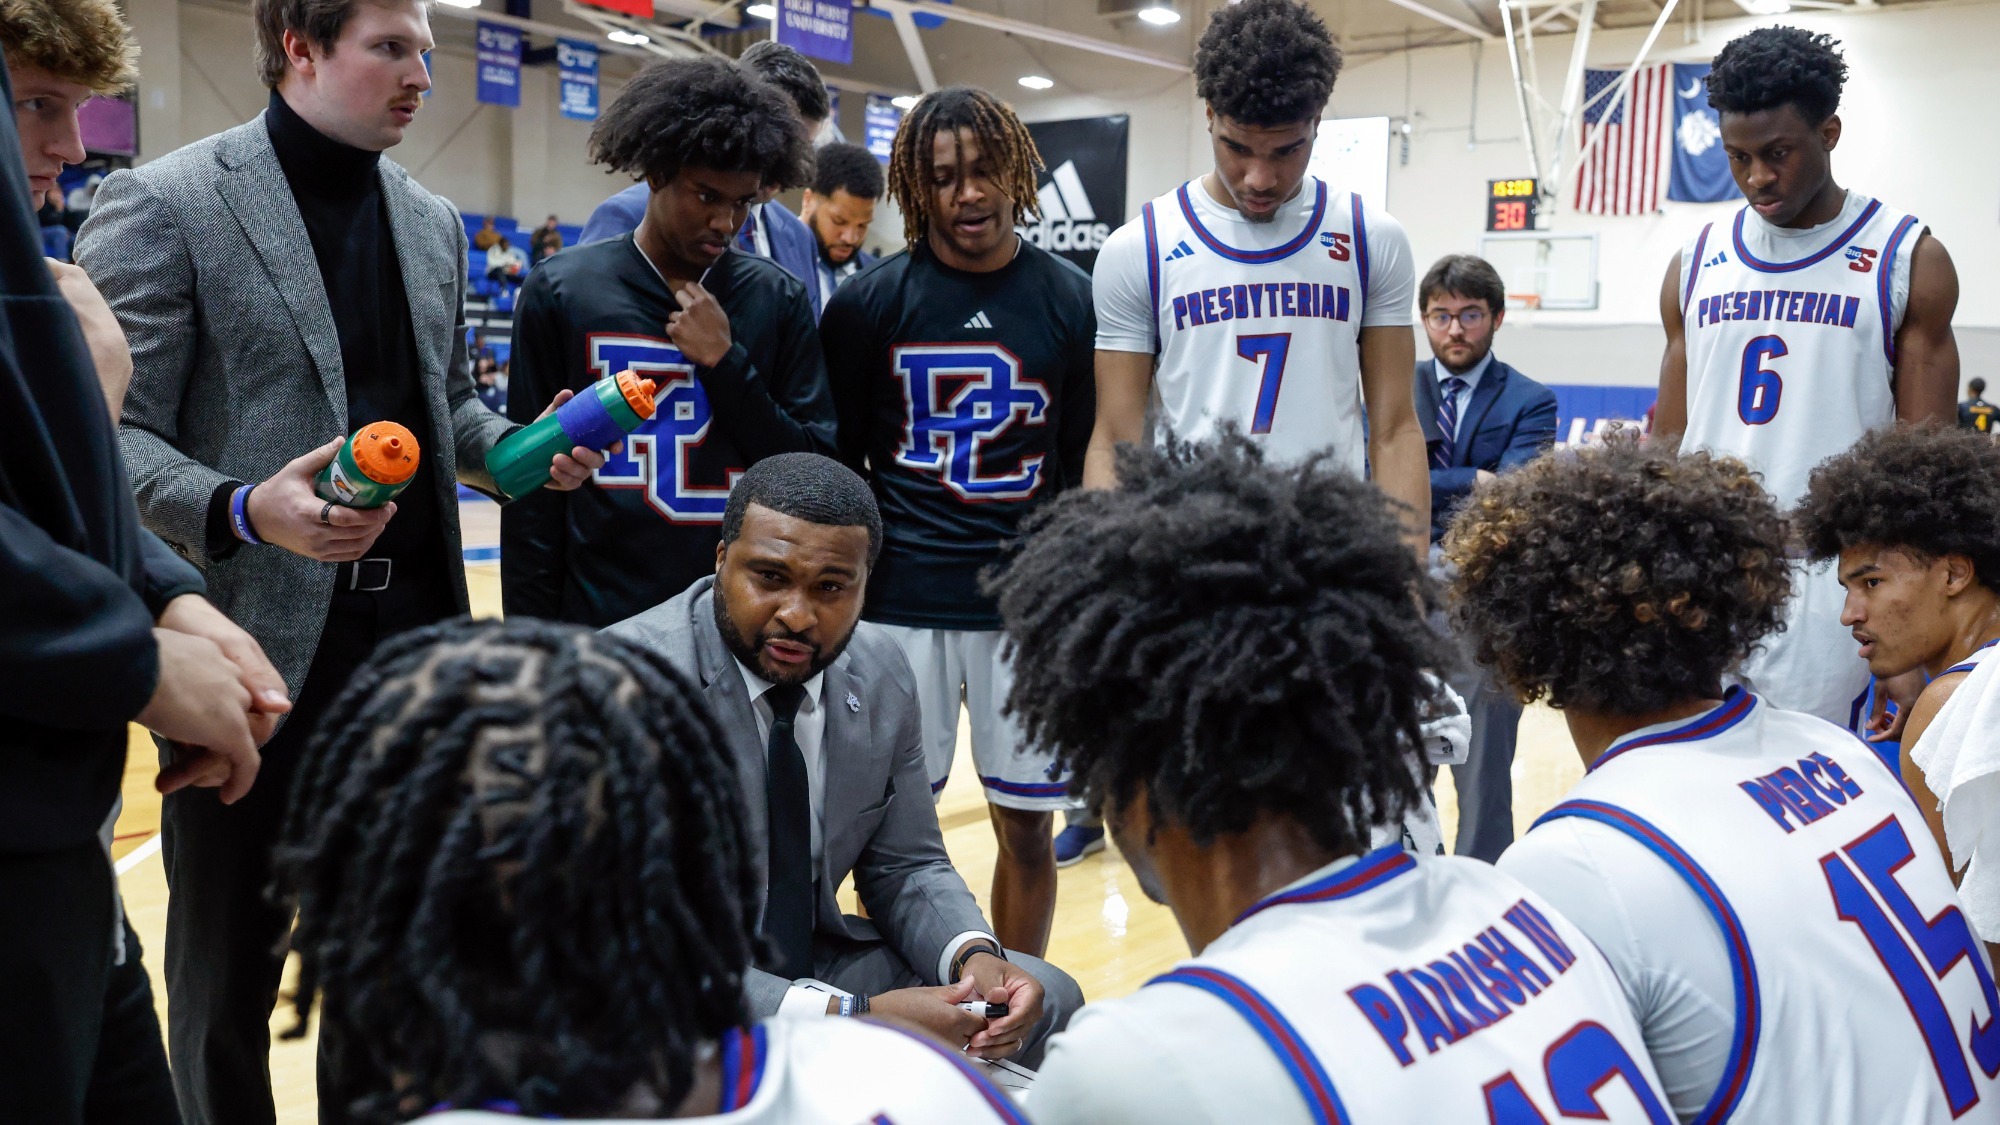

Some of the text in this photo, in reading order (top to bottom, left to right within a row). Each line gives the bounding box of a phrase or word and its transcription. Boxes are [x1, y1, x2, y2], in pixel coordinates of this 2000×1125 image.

[1328, 232, 1350, 262] S
[1493, 202, 1526, 230] 30
[1848, 248, 1878, 273] S
[1172, 282, 1350, 331] PRESBYTERIAN
[1698, 289, 1861, 329] PRESBYTERIAN
[1236, 332, 1292, 434] 7
[1737, 334, 1789, 426] 6
[1737, 751, 1865, 835] PIERCE
[1344, 925, 1555, 1069] PARRISH
[1818, 812, 2000, 1121] 15
